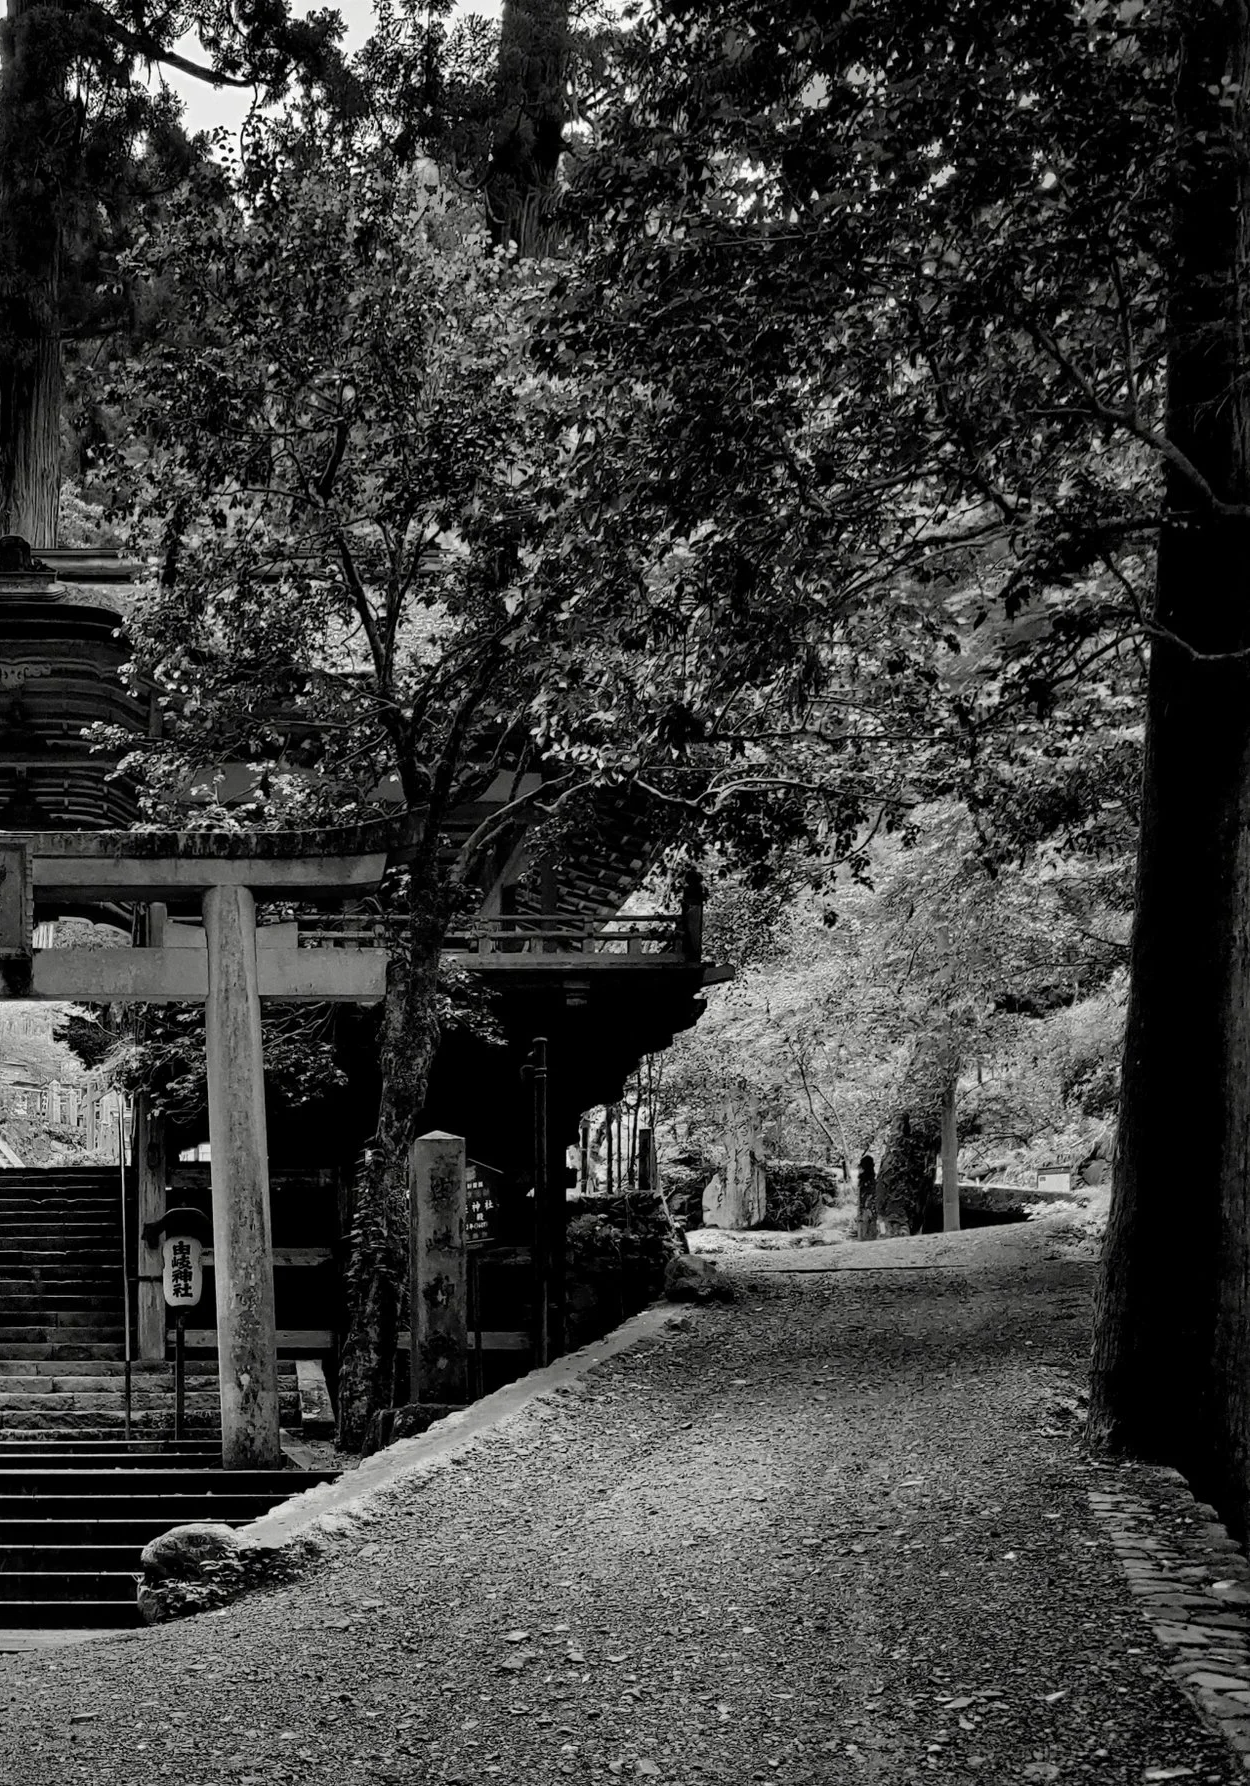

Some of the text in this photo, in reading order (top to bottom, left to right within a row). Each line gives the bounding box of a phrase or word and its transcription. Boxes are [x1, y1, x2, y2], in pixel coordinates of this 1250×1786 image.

[466, 1200, 494, 1213] 神社
[172, 1240, 193, 1298] 由岐神社
